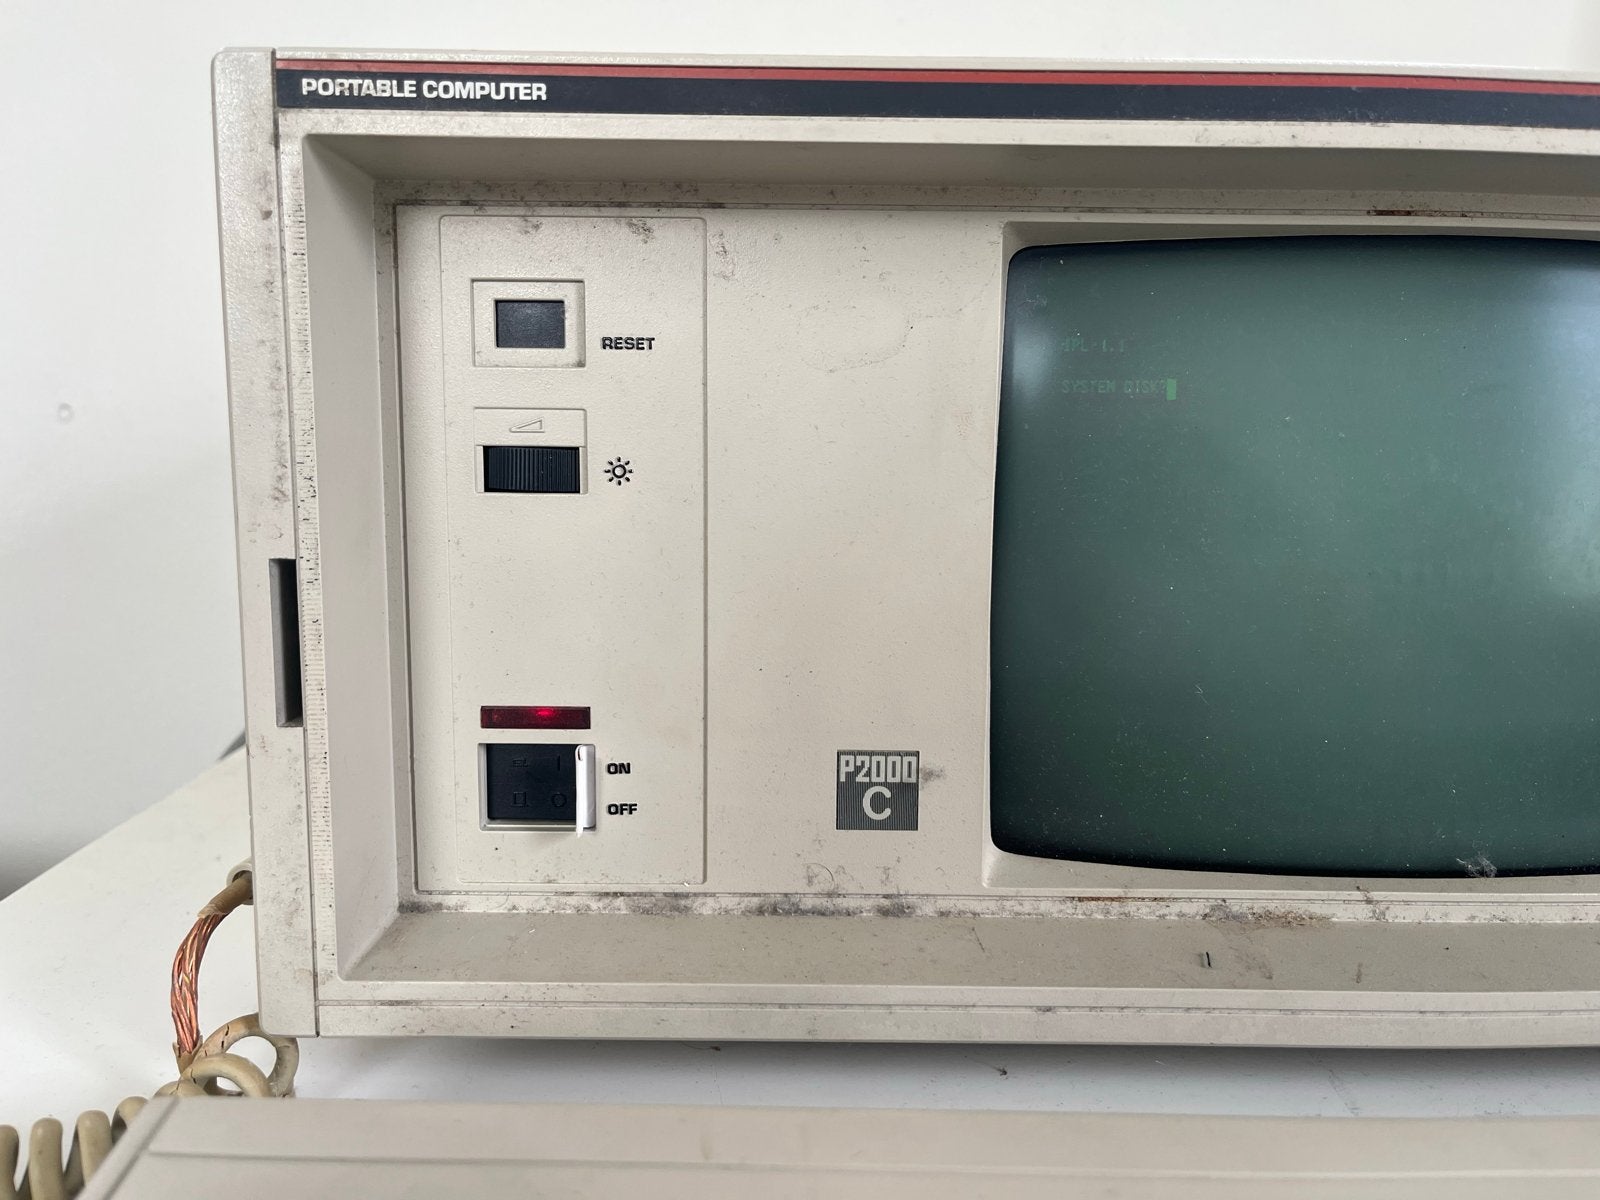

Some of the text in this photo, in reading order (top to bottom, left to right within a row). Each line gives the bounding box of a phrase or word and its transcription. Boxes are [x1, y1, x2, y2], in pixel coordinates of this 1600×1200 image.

[301, 78, 548, 101] PORTABLE COMPUTER
[601, 336, 656, 351] RESET
[1061, 379, 1116, 393] SYSTEM
[606, 762, 631, 775] ON
[839, 754, 918, 783] P2000
[607, 803, 638, 816] OFF
[862, 785, 892, 821] C
